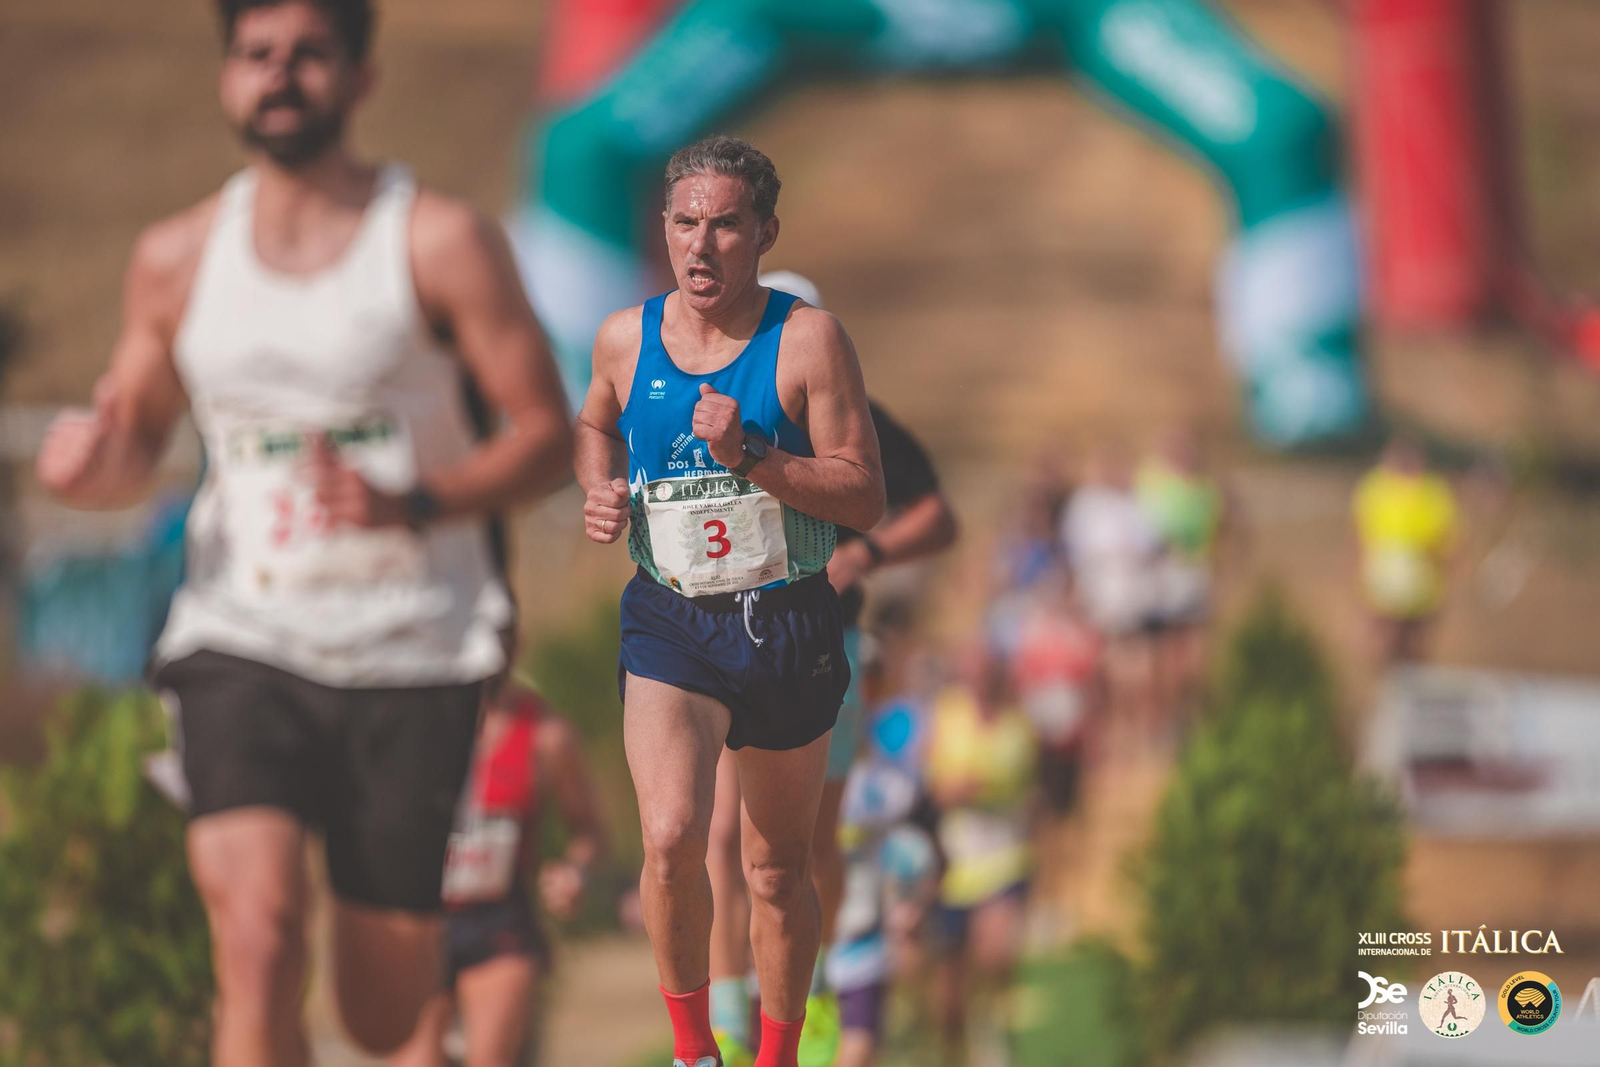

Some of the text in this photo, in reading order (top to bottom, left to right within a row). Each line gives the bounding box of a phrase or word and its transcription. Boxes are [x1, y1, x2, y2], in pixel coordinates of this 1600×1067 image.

[671, 432, 686, 448] CLUB
[667, 460, 689, 470] DOS
[681, 480, 741, 497] ITÁLICA
[703, 519, 732, 559] 3
